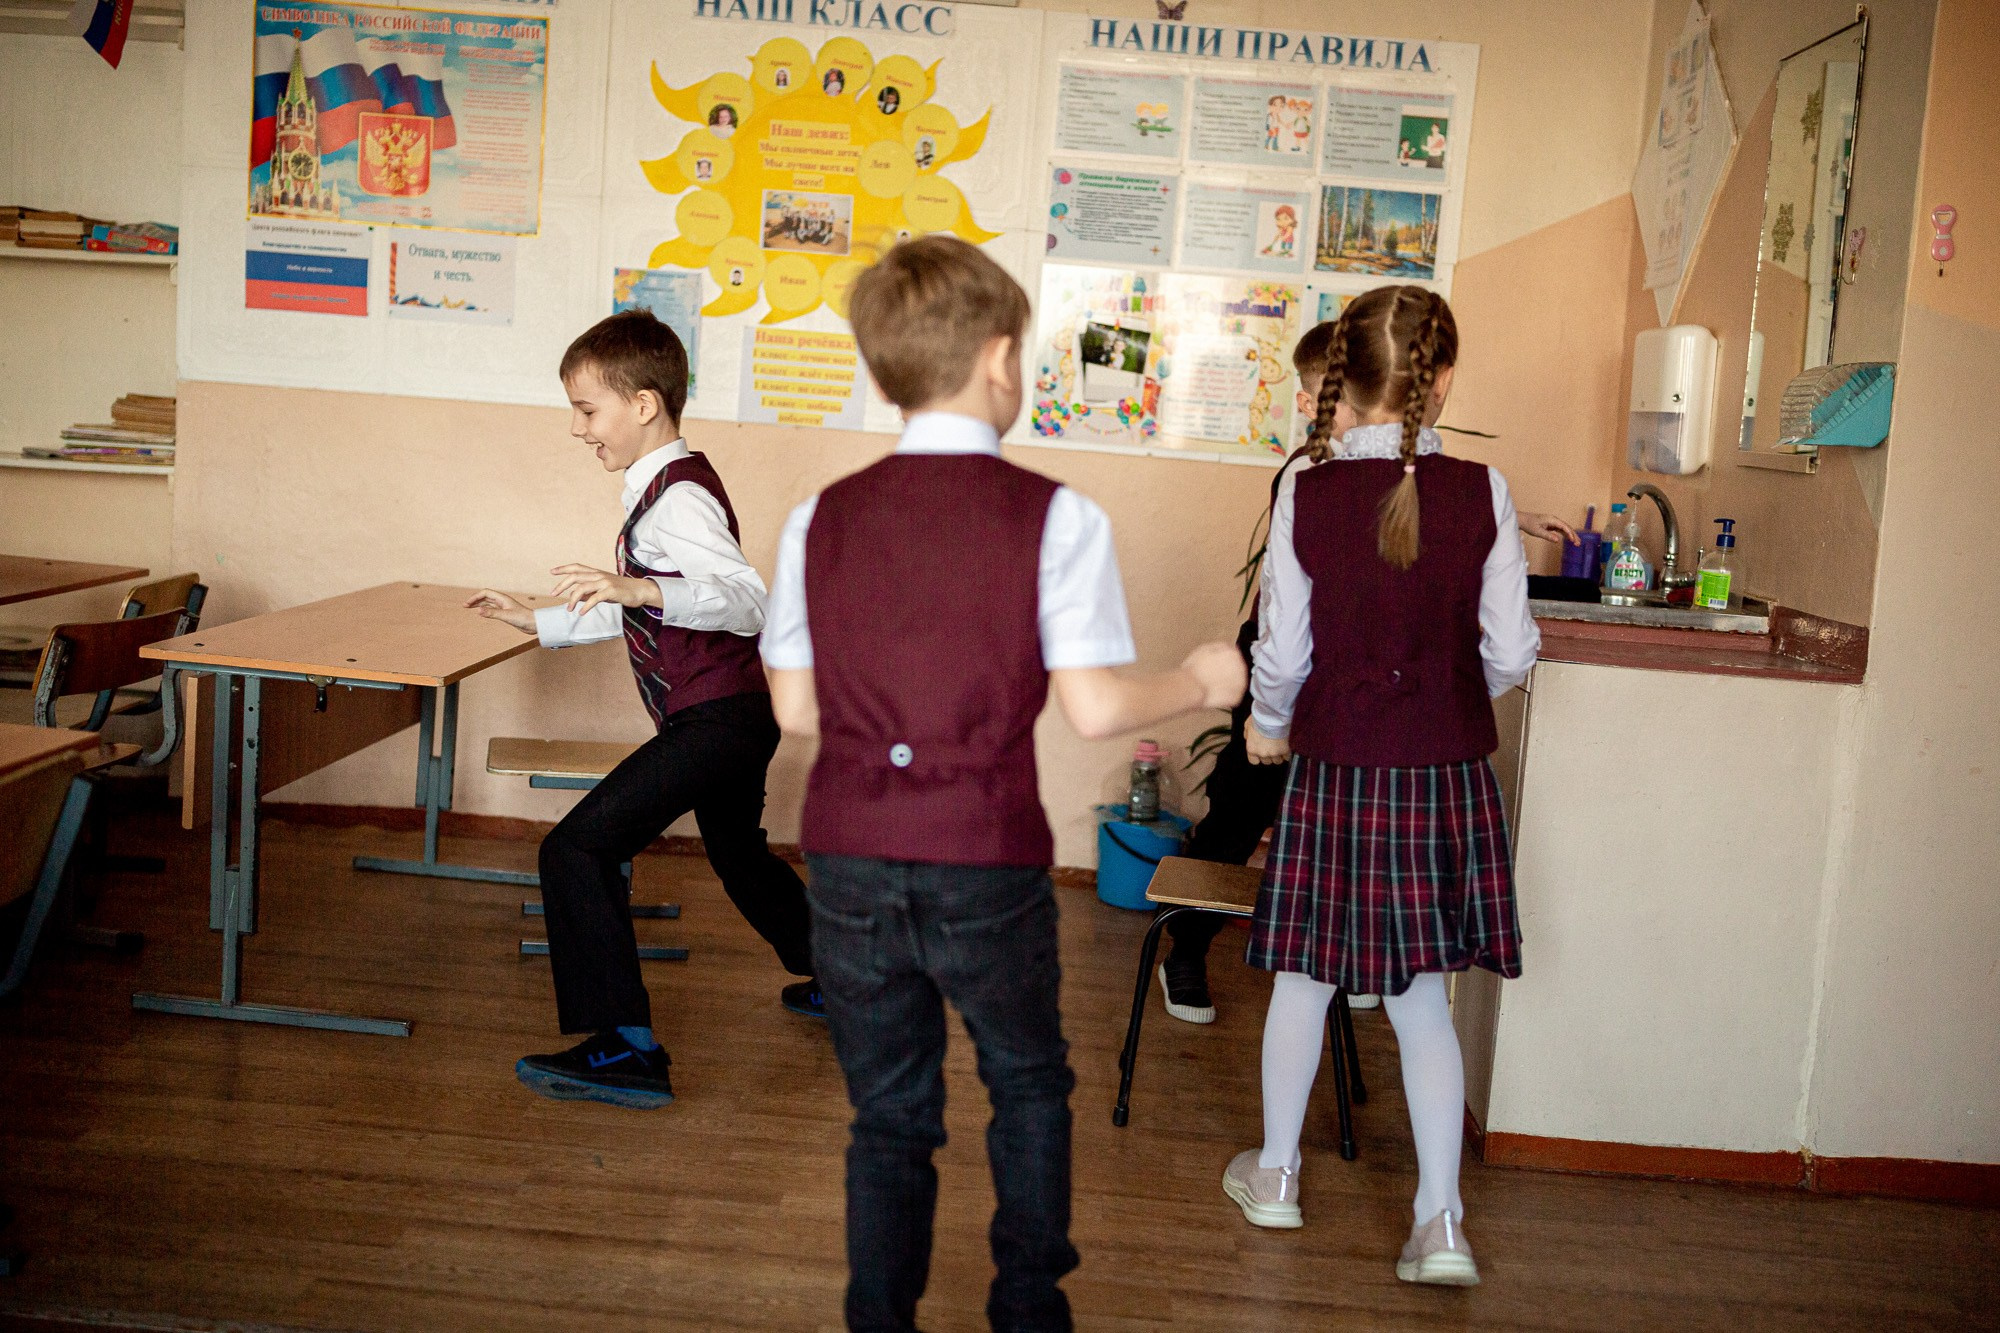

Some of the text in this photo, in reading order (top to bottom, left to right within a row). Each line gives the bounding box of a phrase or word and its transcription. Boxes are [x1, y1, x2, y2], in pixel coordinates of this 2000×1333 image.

[262, 8, 541, 40] СИМВОЛИКА РОССИЙСКОЙ ФЕДЕРАЦИИ
[694, 0, 952, 36] НАШ КЛАСС
[1090, 18, 1435, 73] НАШИ ПРАВИЛА
[771, 124, 804, 138] Наш
[408, 243, 502, 263] Отвага, мужество
[433, 270, 441, 280] и
[755, 330, 794, 343] Наша
